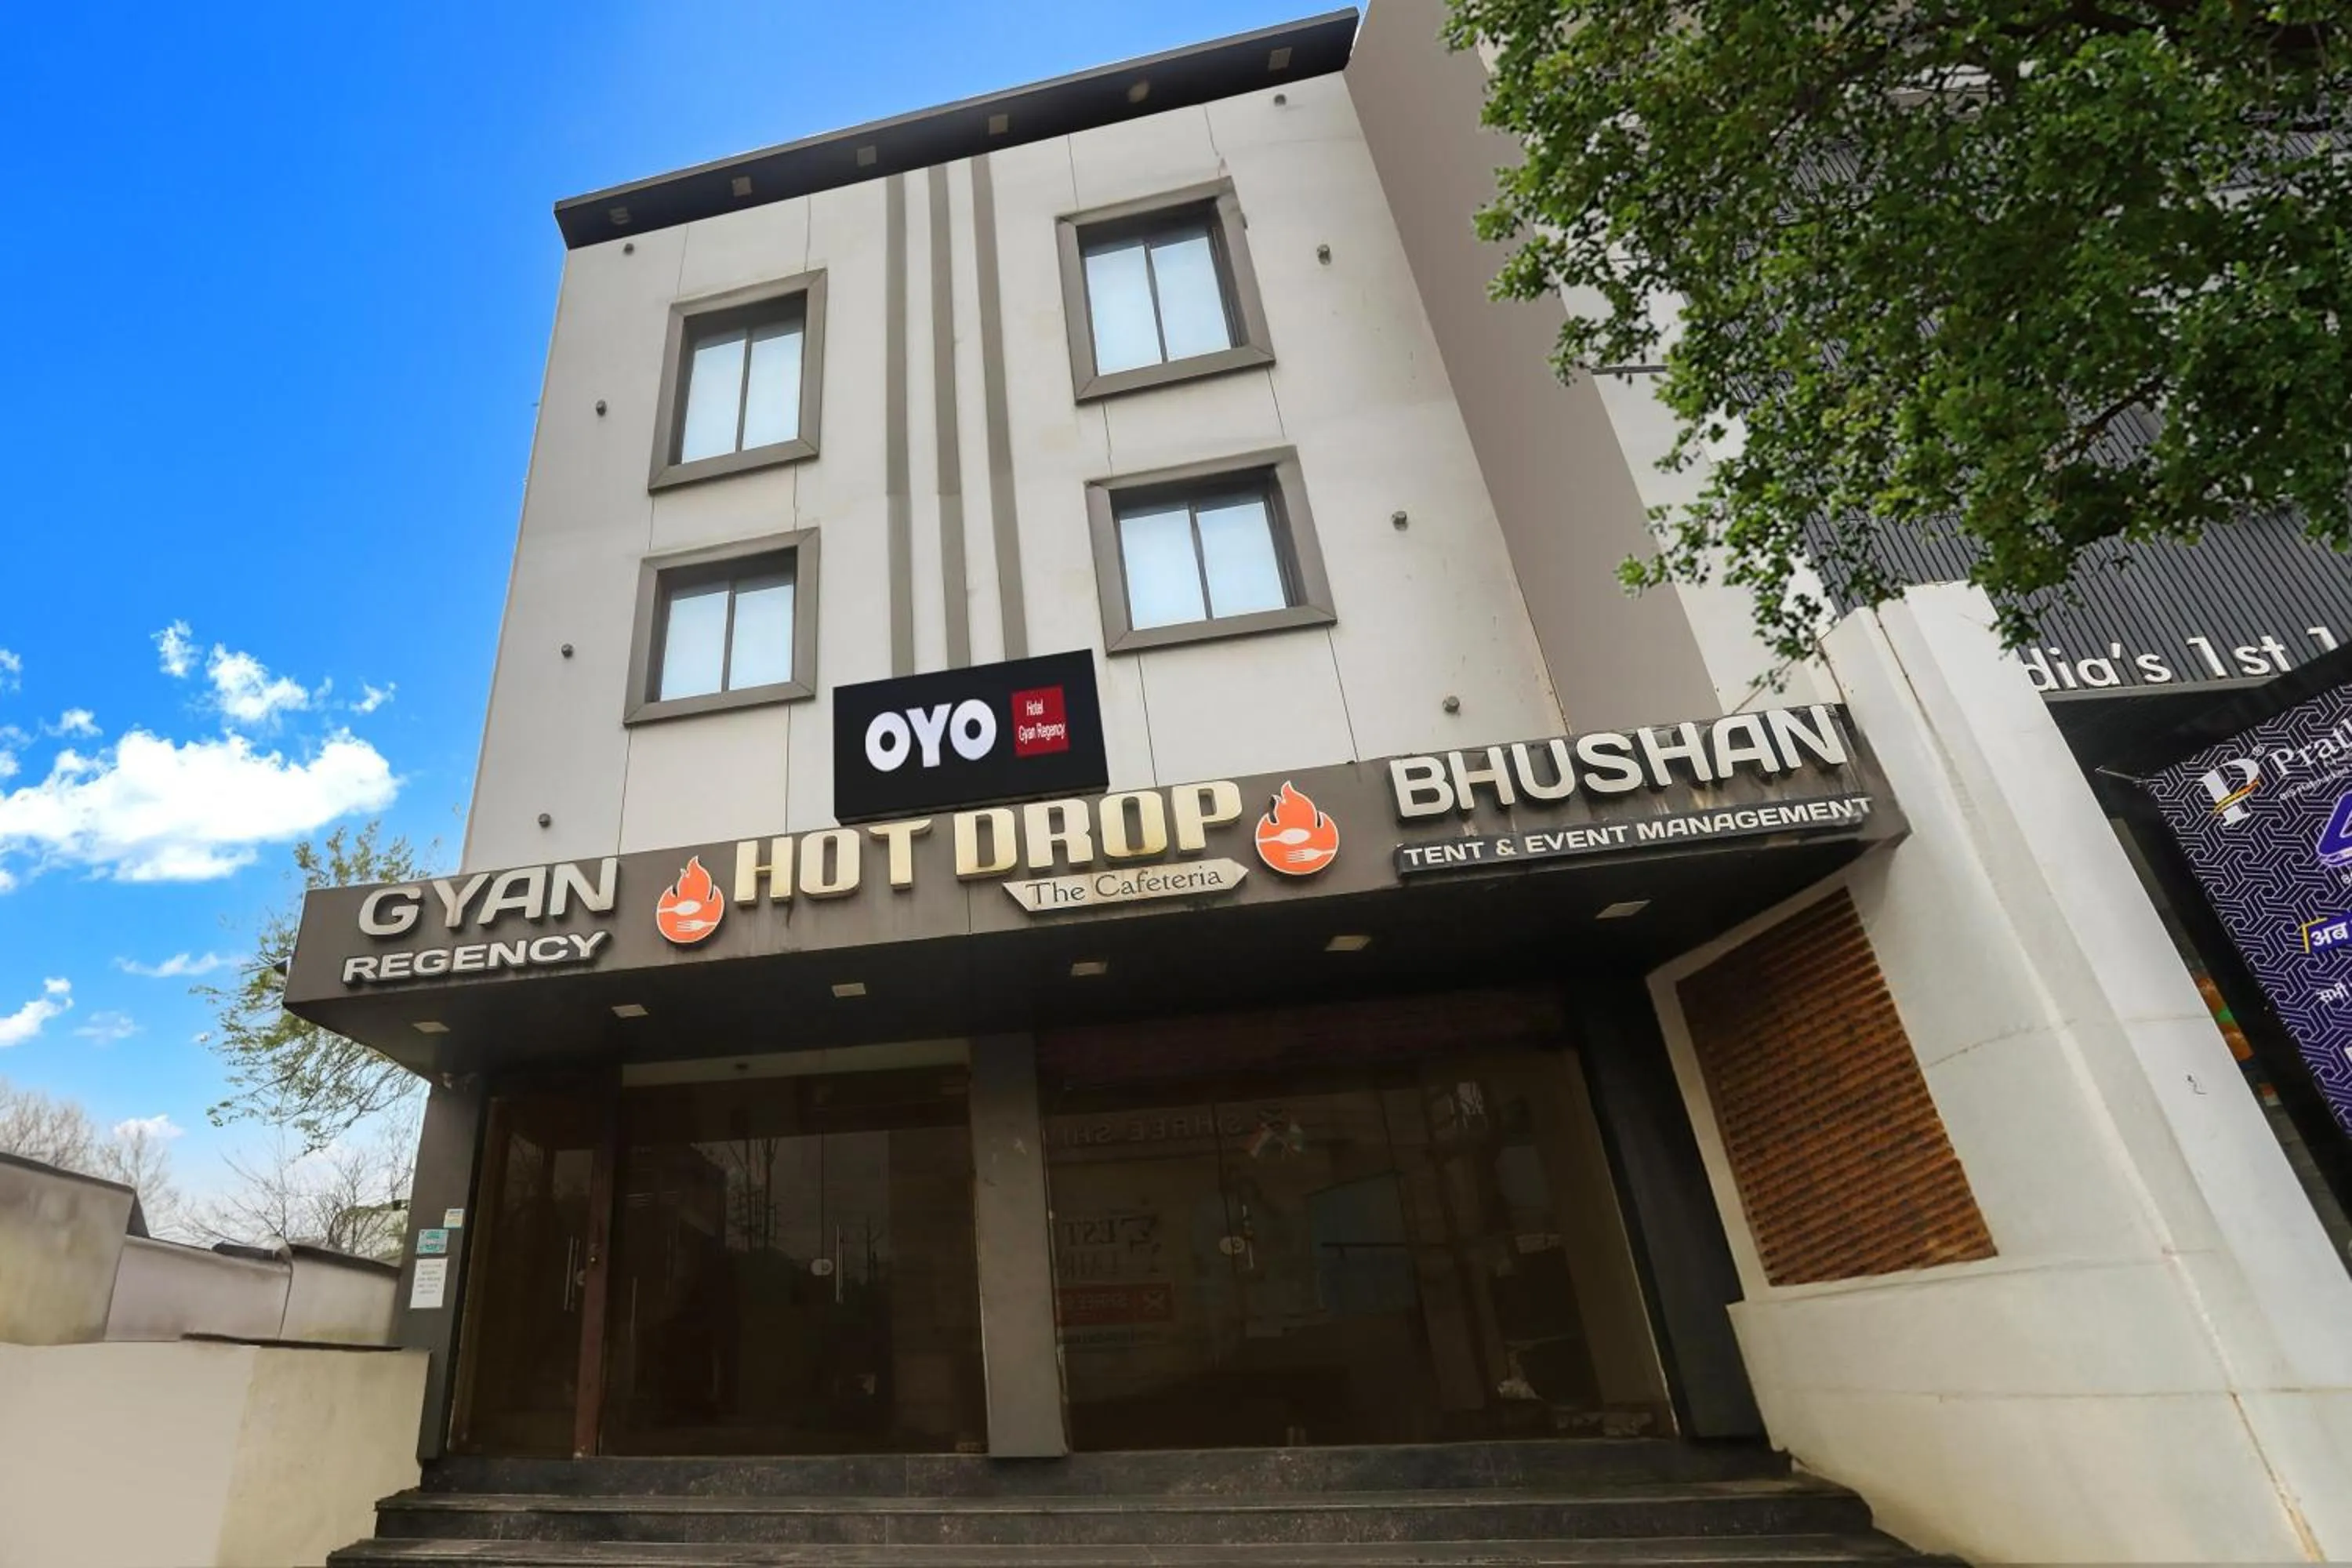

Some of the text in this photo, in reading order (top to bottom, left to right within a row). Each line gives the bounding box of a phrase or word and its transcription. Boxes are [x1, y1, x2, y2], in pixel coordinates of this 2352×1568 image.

[2187, 635, 2292, 677] 1st
[1025, 698, 1044, 716] Hotel
[865, 699, 996, 771] OYO
[1018, 724, 1036, 744] Gyan
[1389, 704, 1847, 818] BHUSHAN
[734, 781, 1243, 906] HOT DROP
[1403, 794, 1873, 866] TENT & EVENT MANAGEMENT
[358, 857, 618, 936] GYAN
[1025, 866, 1224, 906] The Cafeteria
[343, 931, 610, 984] REGENCY
[2310, 921, 2350, 947] अब
